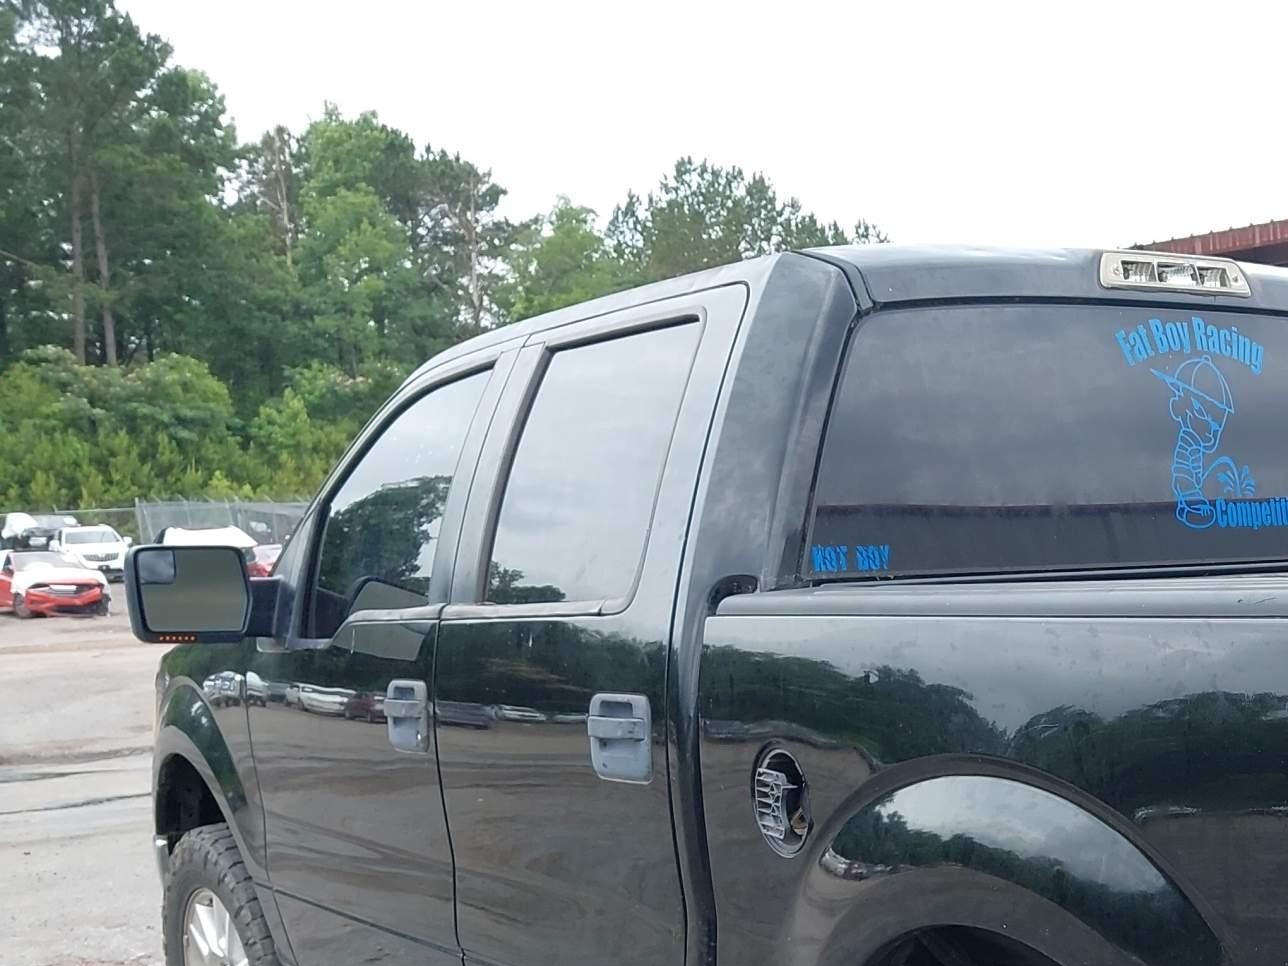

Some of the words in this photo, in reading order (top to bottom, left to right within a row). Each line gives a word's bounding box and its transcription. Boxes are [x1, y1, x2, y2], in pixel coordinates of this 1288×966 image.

[1115, 323, 1155, 367] Fat
[1148, 318, 1191, 354] Boy
[1191, 316, 1265, 376] Racing
